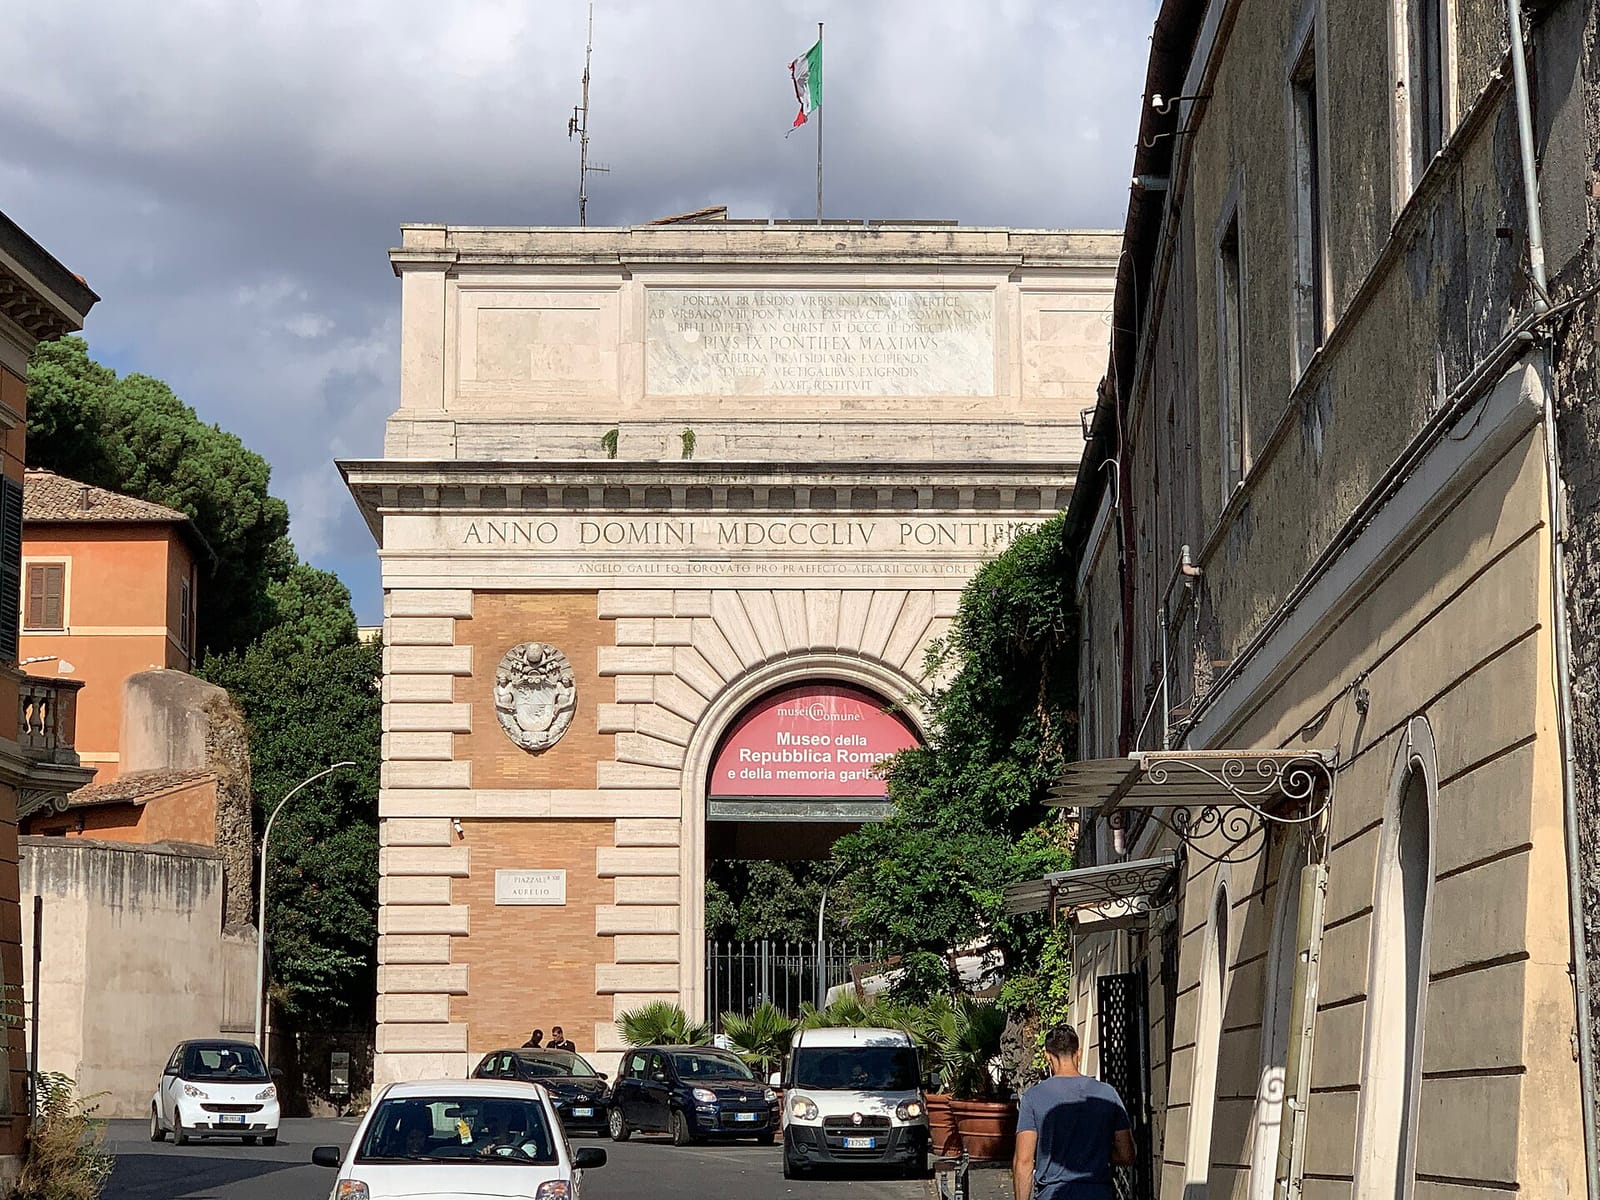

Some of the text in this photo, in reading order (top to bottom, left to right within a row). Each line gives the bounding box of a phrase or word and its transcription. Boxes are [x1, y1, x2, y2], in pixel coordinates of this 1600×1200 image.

[682, 295, 730, 306] PORTAM
[736, 295, 795, 306] PRAESIDIO
[801, 296, 832, 307] VRBIS
[838, 296, 851, 307] IN
[913, 296, 960, 307] VERTICE
[649, 309, 665, 319] AB
[671, 309, 722, 319] VRBANO
[789, 309, 815, 319] MAX
[783, 322, 823, 333] CHRIST
[832, 322, 841, 333] M
[704, 335, 938, 350] PIVS IX PONTIFEX MAXIMVS
[859, 367, 919, 377] EXIGENDIS
[813, 380, 873, 390] RESTITVIT
[463, 522, 558, 545] ANNO
[579, 522, 695, 545] DOMINI
[717, 522, 877, 545] MDCCCLIV
[577, 563, 622, 573] ANGELO
[627, 563, 660, 573] GALLI
[686, 564, 751, 574] TORQVATO
[755, 564, 778, 573] PRO
[776, 732, 867, 746] Museo della
[739, 748, 832, 765] Repubblica
[727, 770, 736, 779] e
[740, 768, 772, 779] della
[776, 768, 835, 779] memoria
[512, 888, 550, 896] AURELIO
